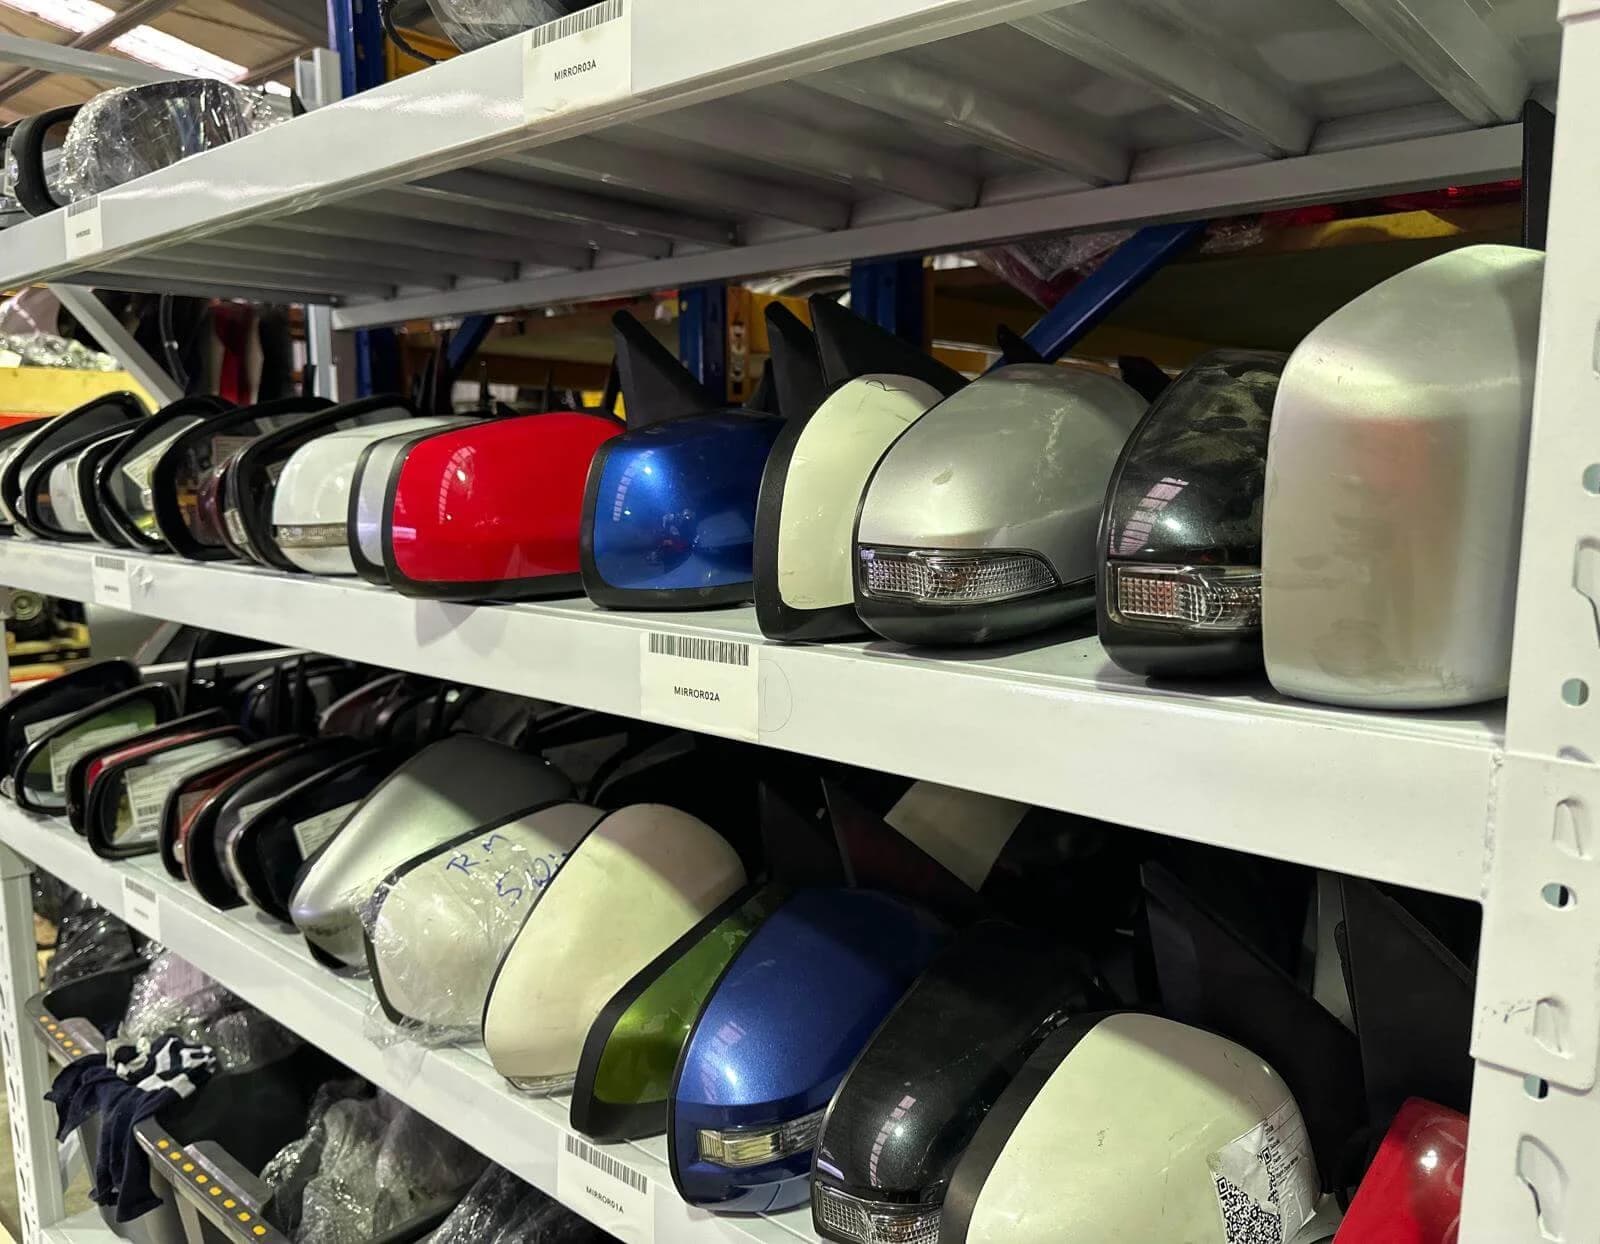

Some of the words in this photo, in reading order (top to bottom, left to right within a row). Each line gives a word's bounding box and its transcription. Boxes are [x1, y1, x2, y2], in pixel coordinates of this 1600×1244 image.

[553, 59, 597, 82] MIRROR03A
[673, 686, 721, 702] MIRROR02A
[585, 1186, 625, 1214] MIRROR01A
